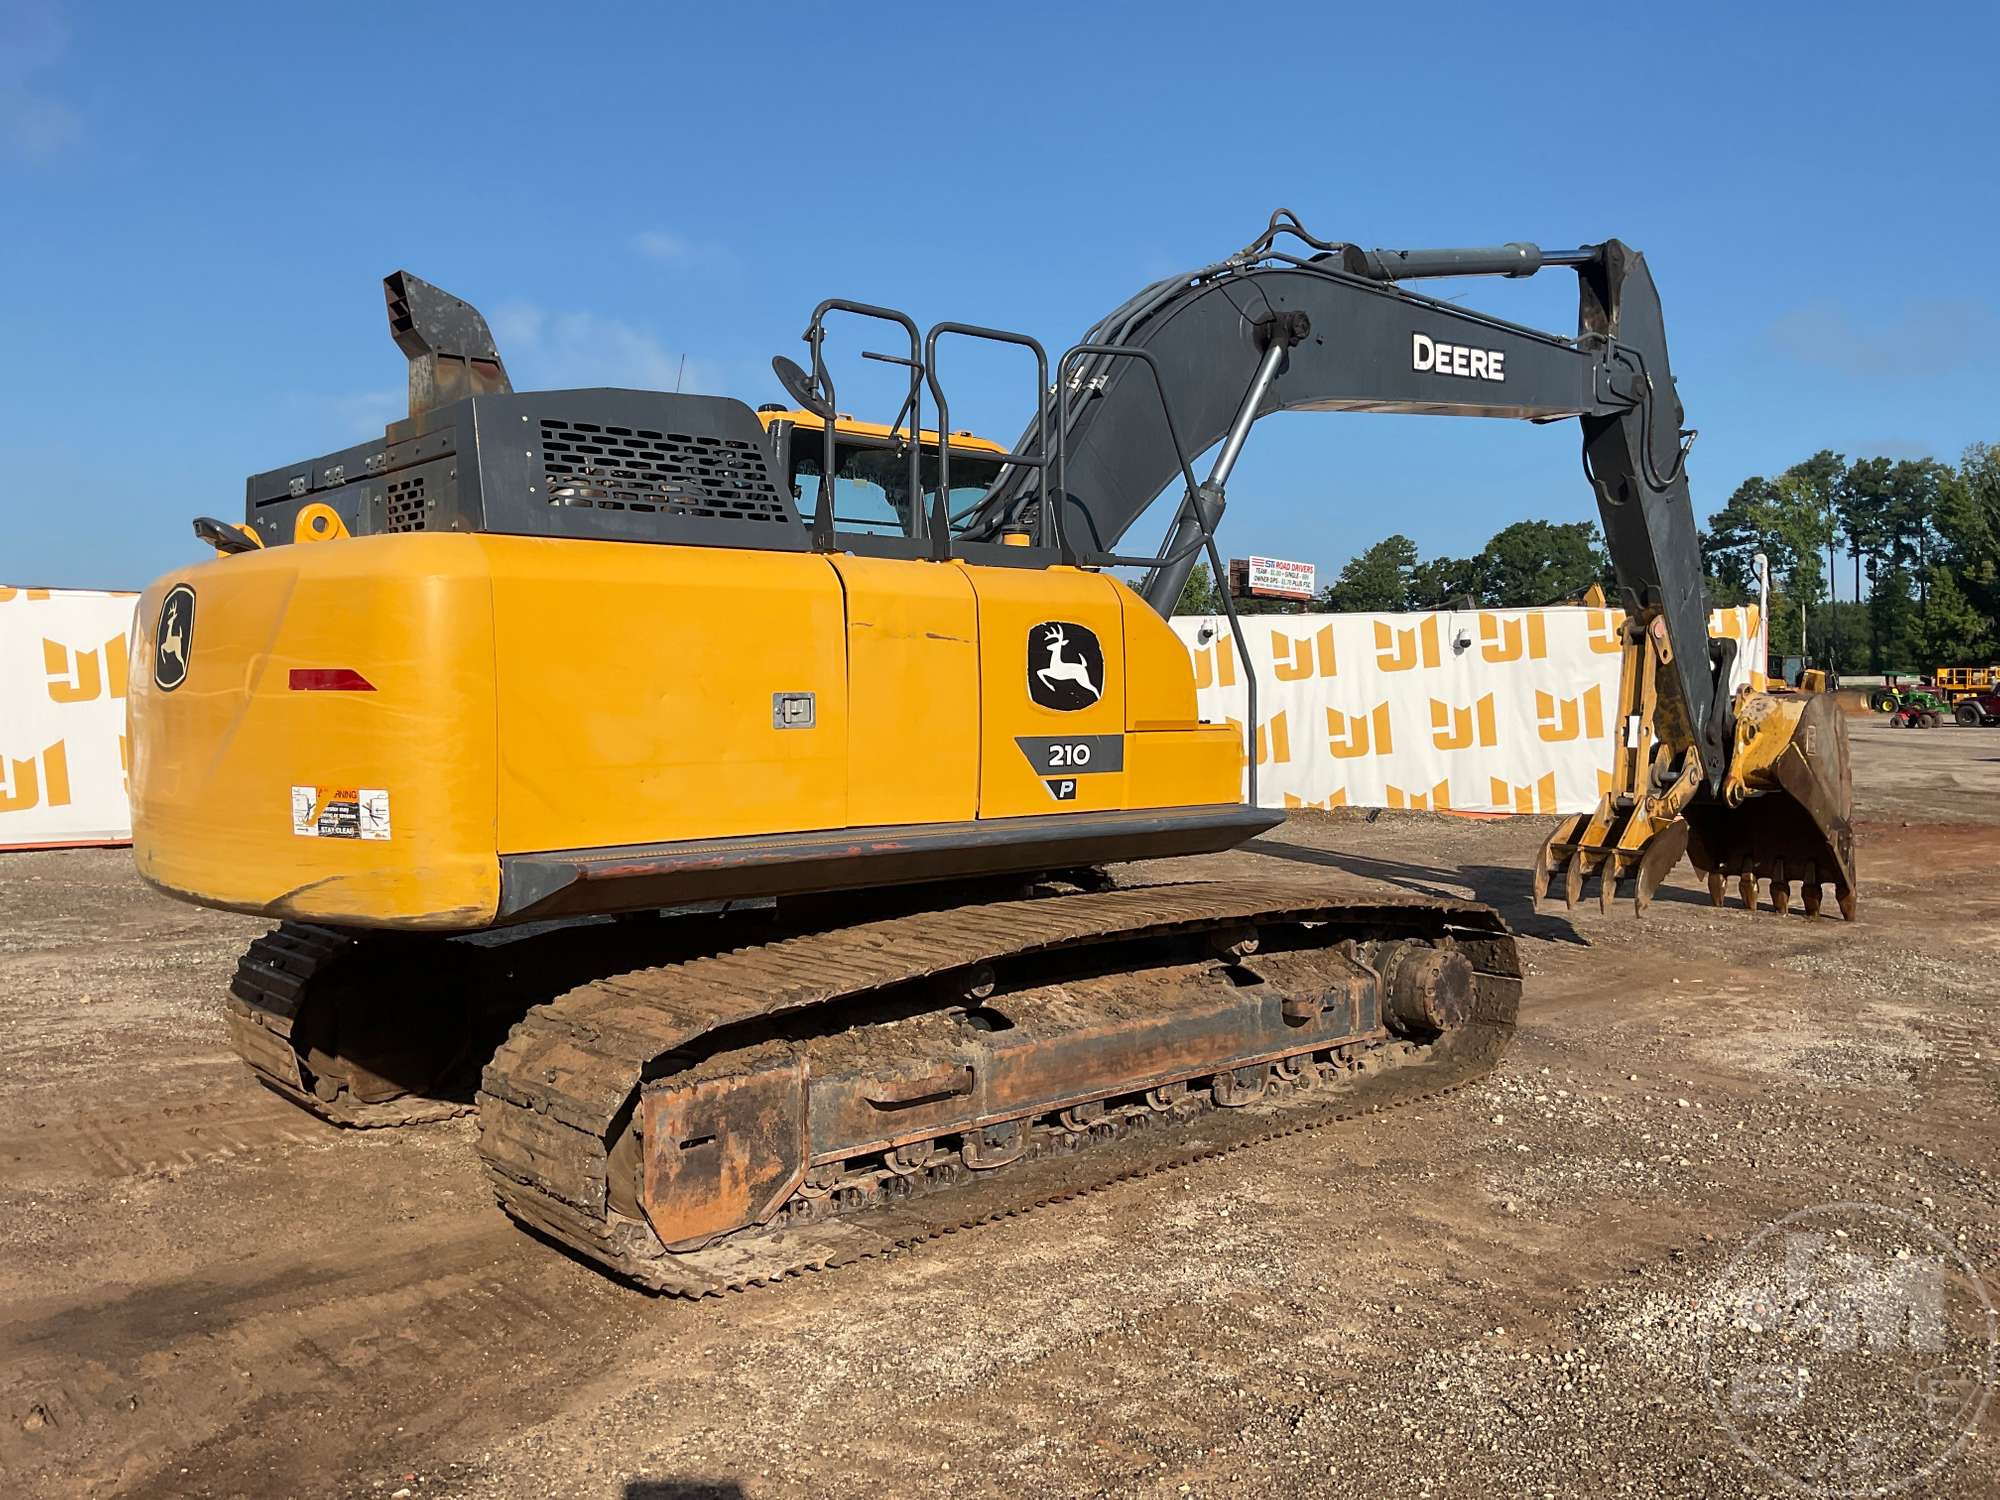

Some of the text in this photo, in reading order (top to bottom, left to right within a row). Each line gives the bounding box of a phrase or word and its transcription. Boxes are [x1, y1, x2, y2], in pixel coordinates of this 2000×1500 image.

[1413, 334, 1505, 381] DEERE
[1275, 561, 1290, 571] ROAD
[1291, 564, 1313, 574] DRIVERS
[1049, 744, 1091, 766] 210
[1059, 781, 1074, 798] P
[320, 826, 334, 834] STAY
